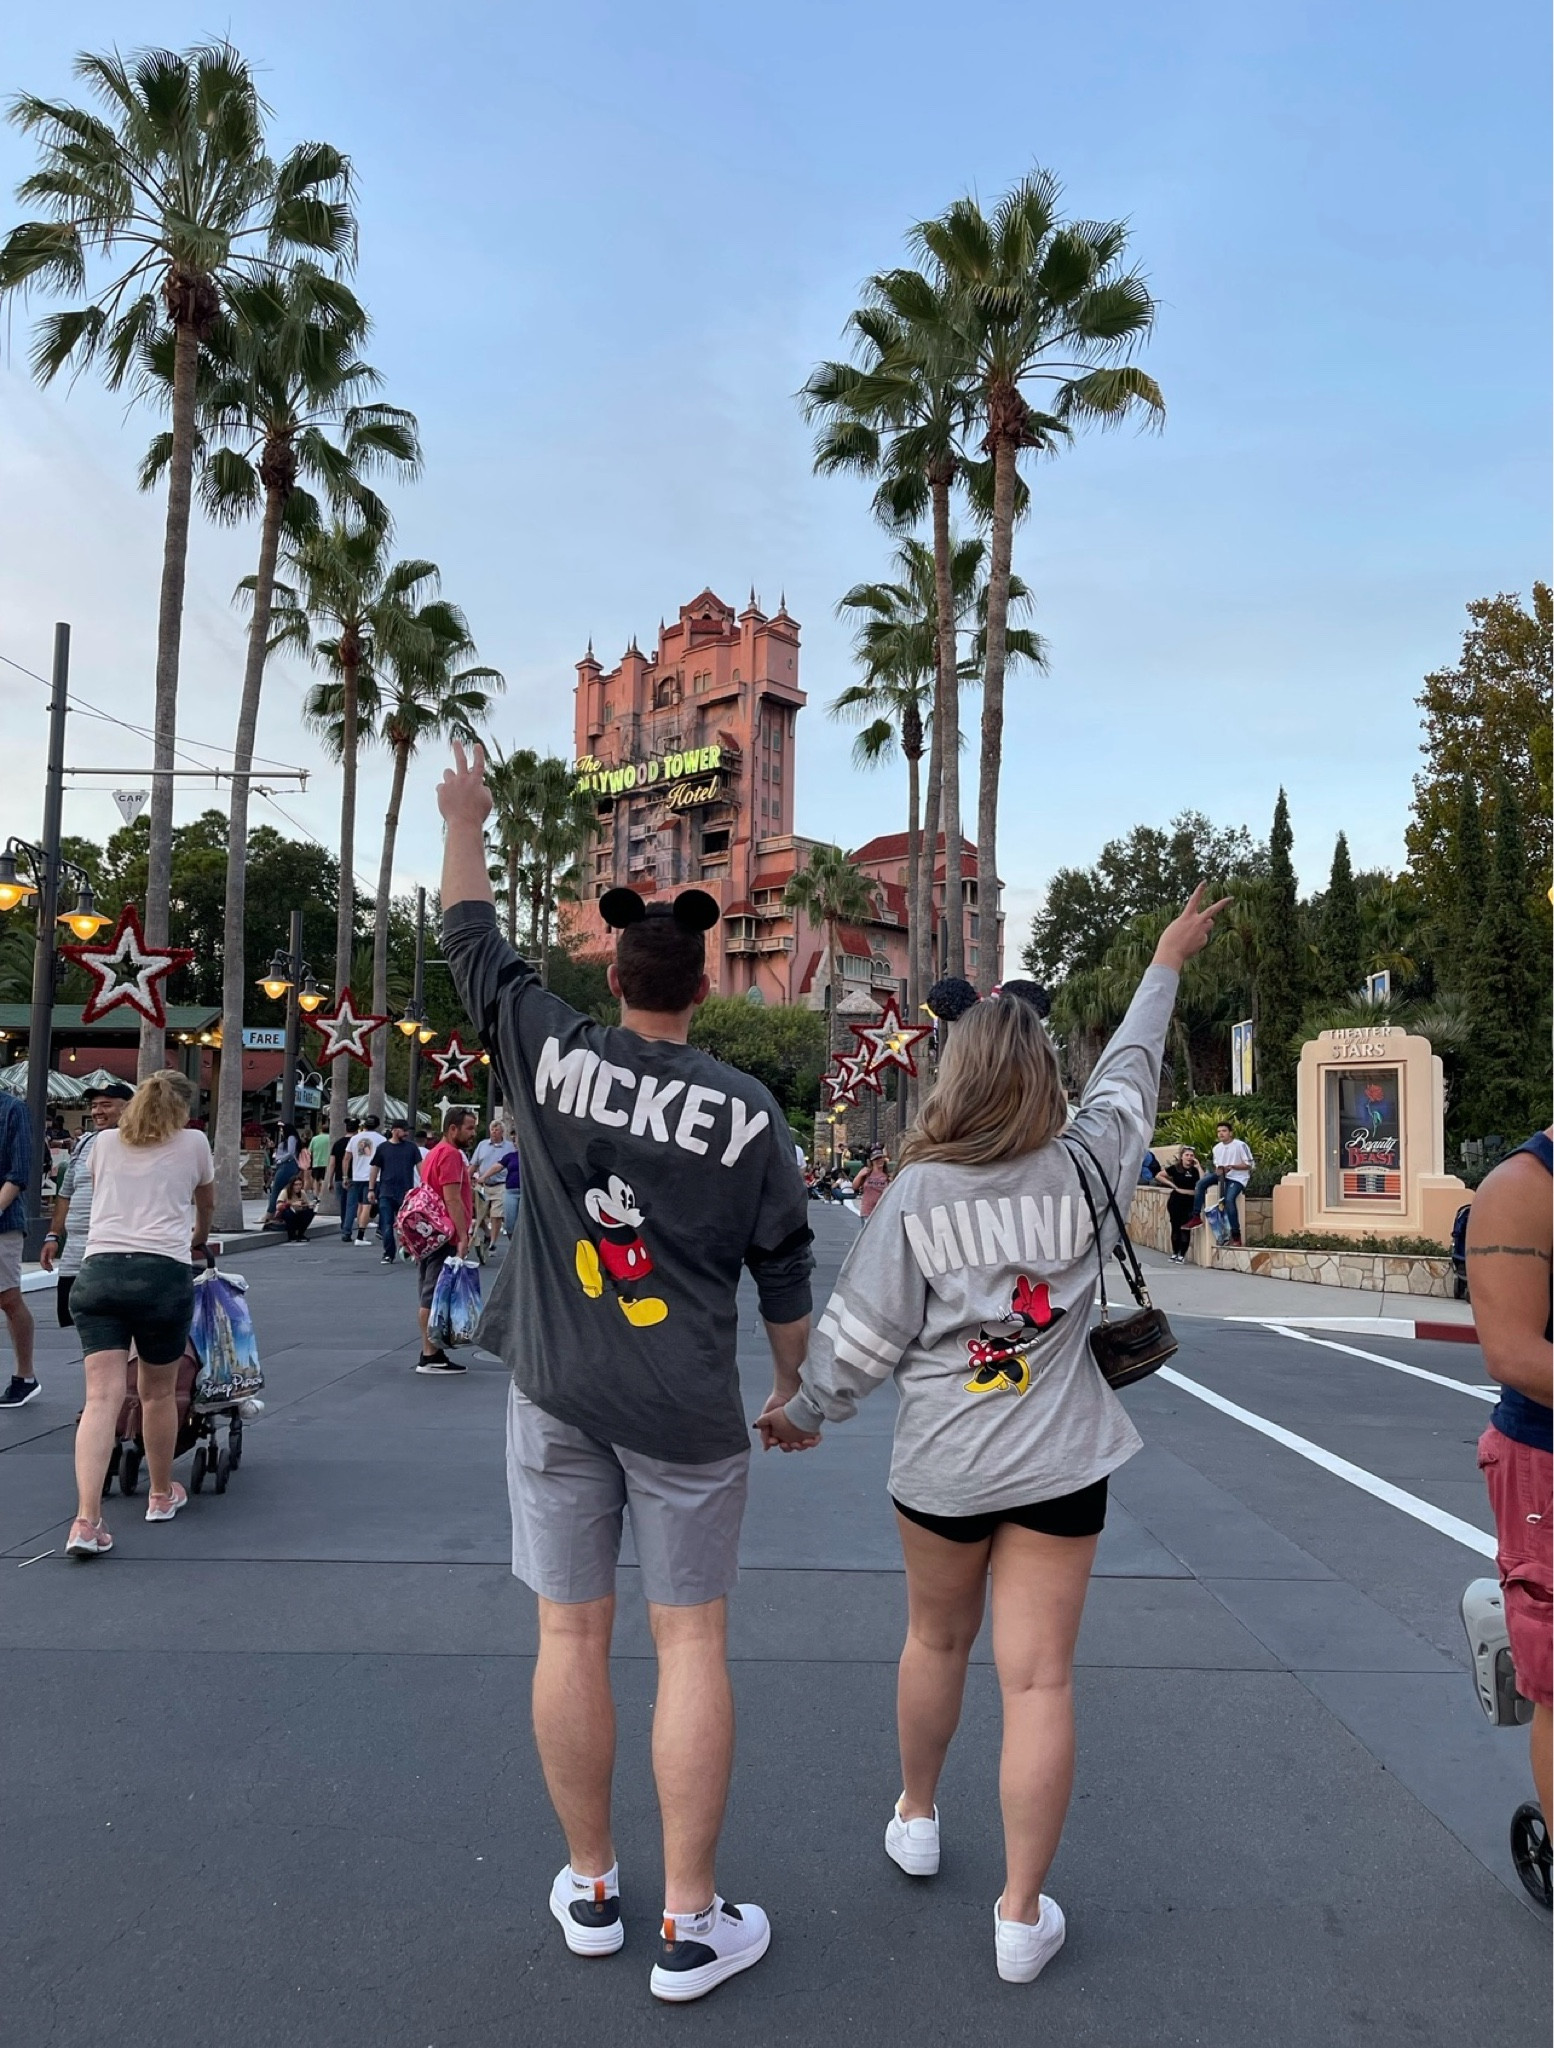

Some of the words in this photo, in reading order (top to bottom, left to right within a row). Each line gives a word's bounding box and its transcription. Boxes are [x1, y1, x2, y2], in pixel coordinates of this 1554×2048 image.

[576, 754, 602, 772] The
[664, 745, 721, 779] TOWER
[665, 774, 718, 809] Hotel
[249, 1032, 280, 1045] FARE
[1329, 1026, 1392, 1039] THEATER
[1332, 1043, 1386, 1059] STARS
[535, 1036, 770, 1168] MICKEY
[1344, 1127, 1400, 1155] Beauty
[1348, 1147, 1396, 1167] BEAST
